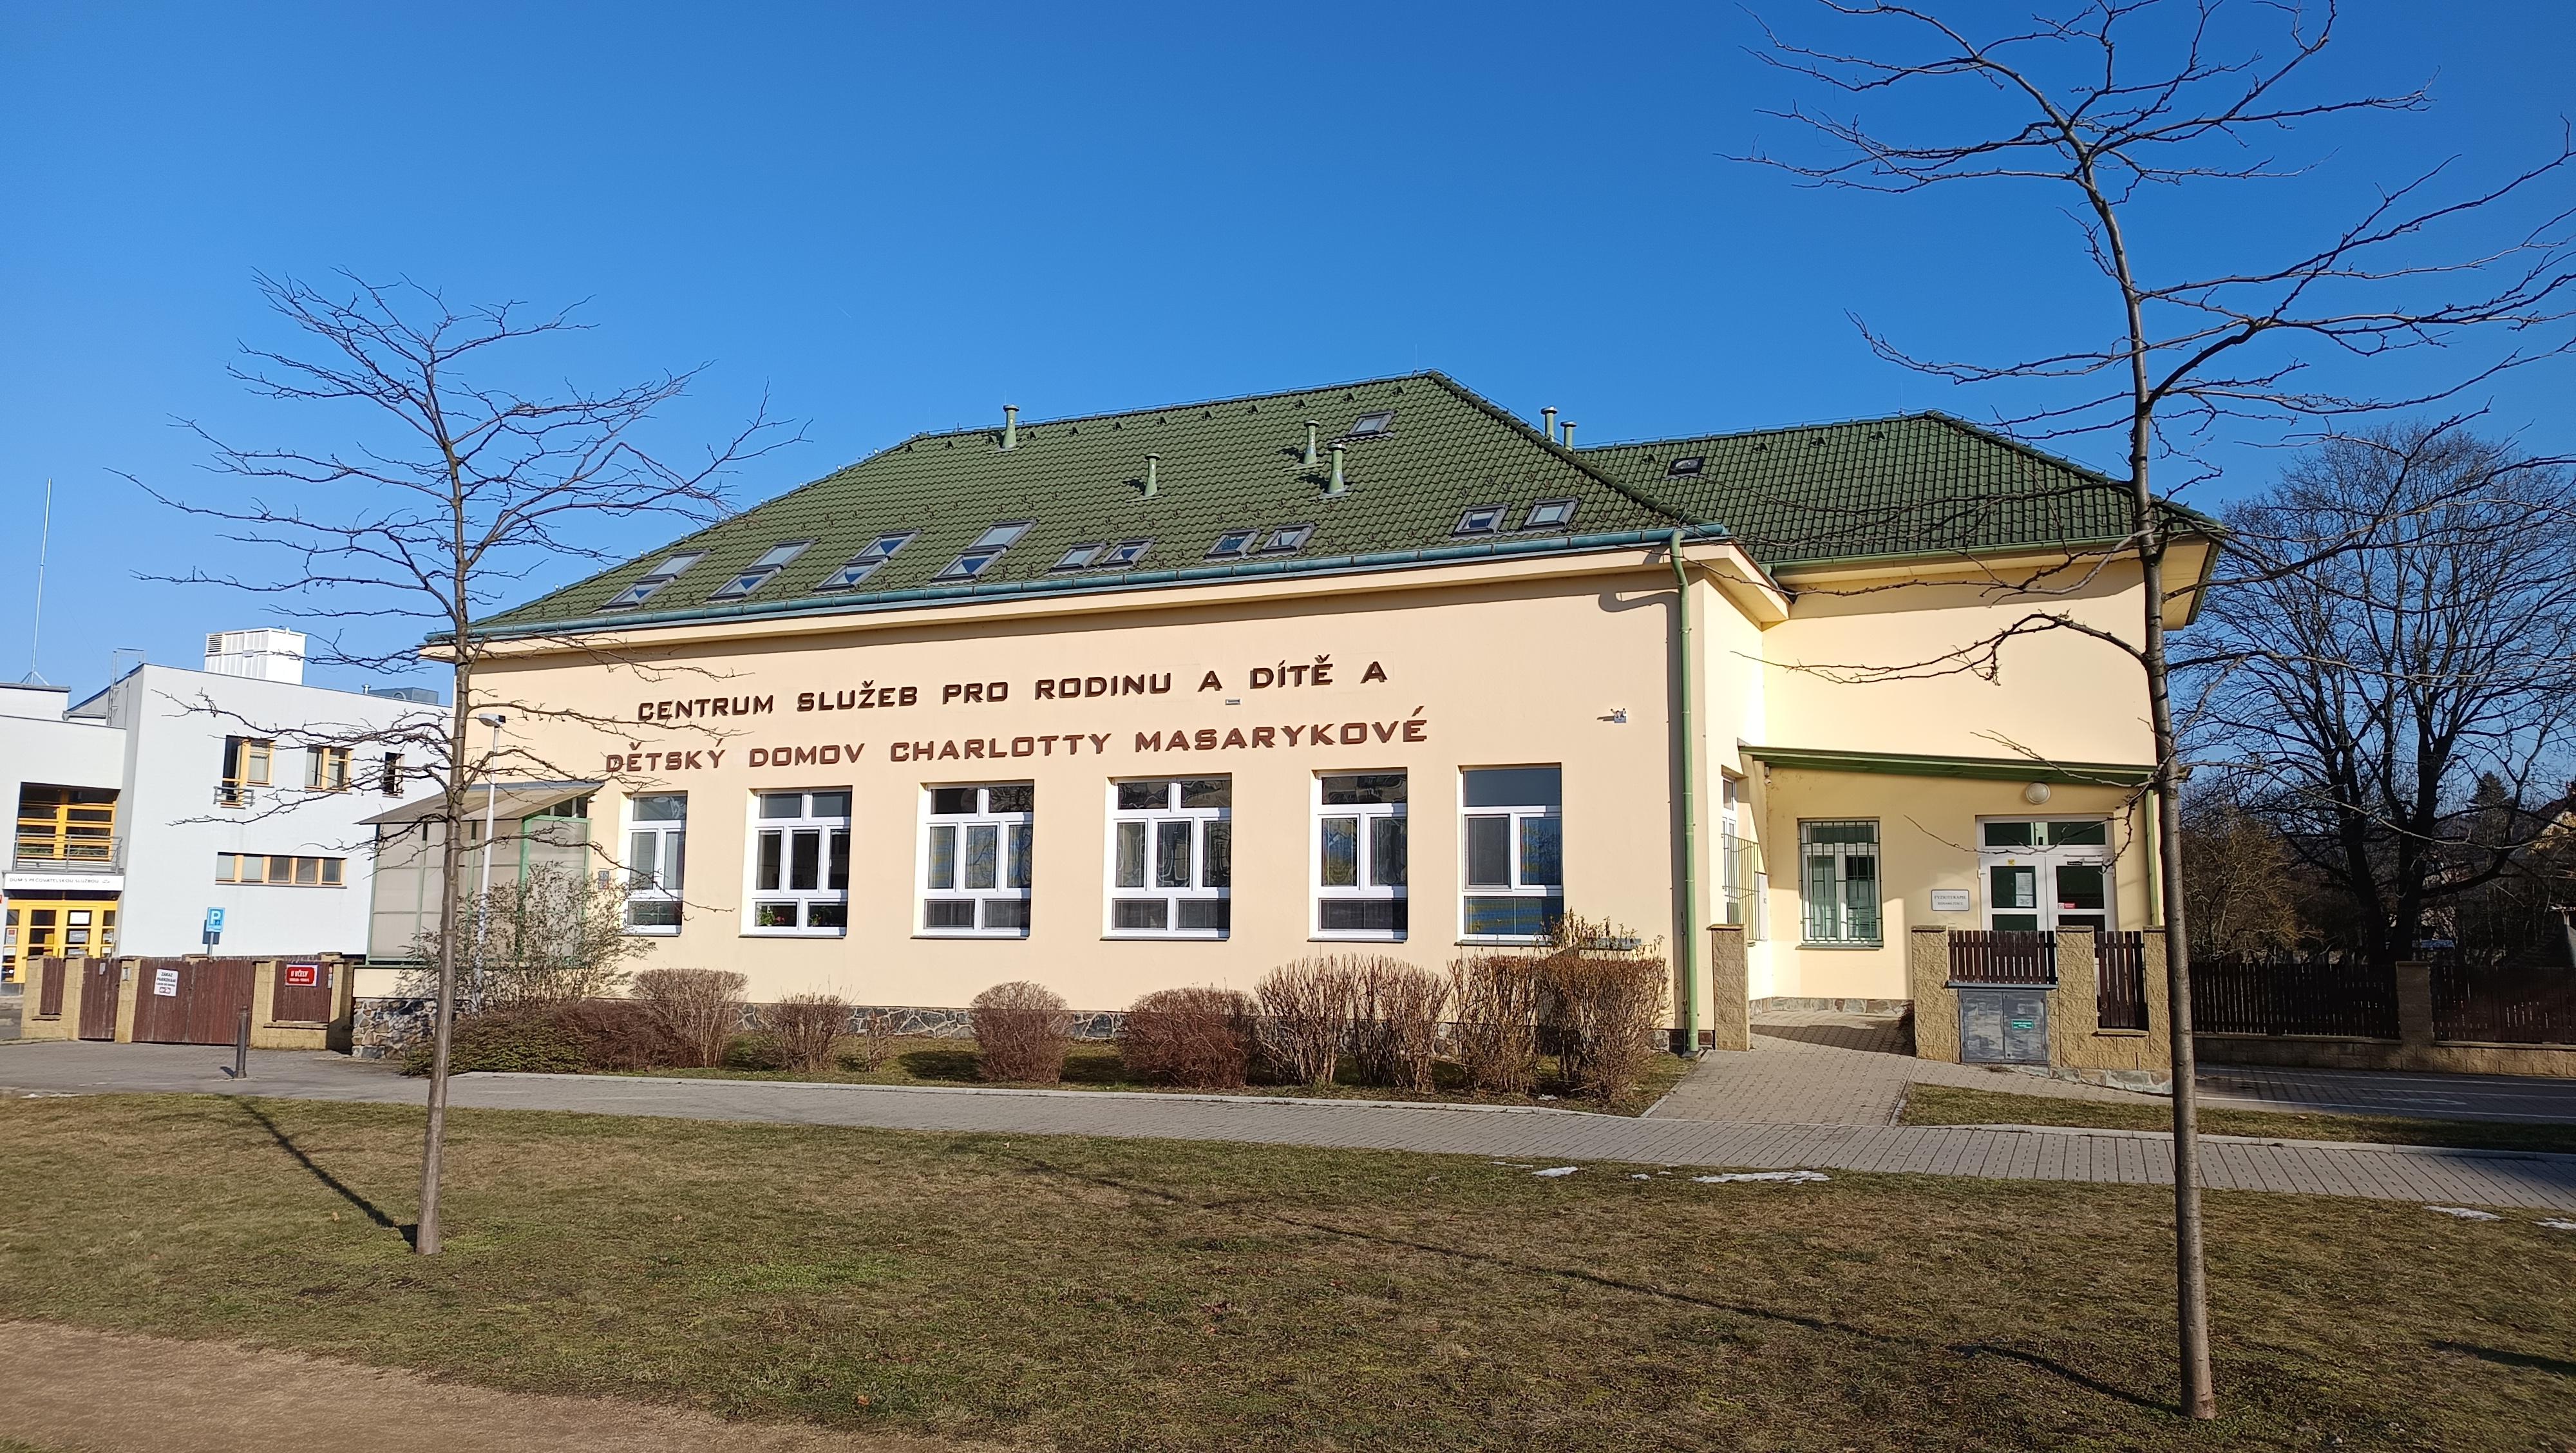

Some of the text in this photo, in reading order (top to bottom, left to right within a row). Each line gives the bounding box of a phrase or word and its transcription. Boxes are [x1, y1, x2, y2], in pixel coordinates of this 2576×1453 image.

[638, 654, 1388, 721] CENTRUM SLUŽEB PRO RODINU A DÍTĚ A
[606, 705, 1428, 772] DĚTSKÝ DOMOV CHARLOTTY MASARYKOVÉ
[210, 910, 221, 924] P
